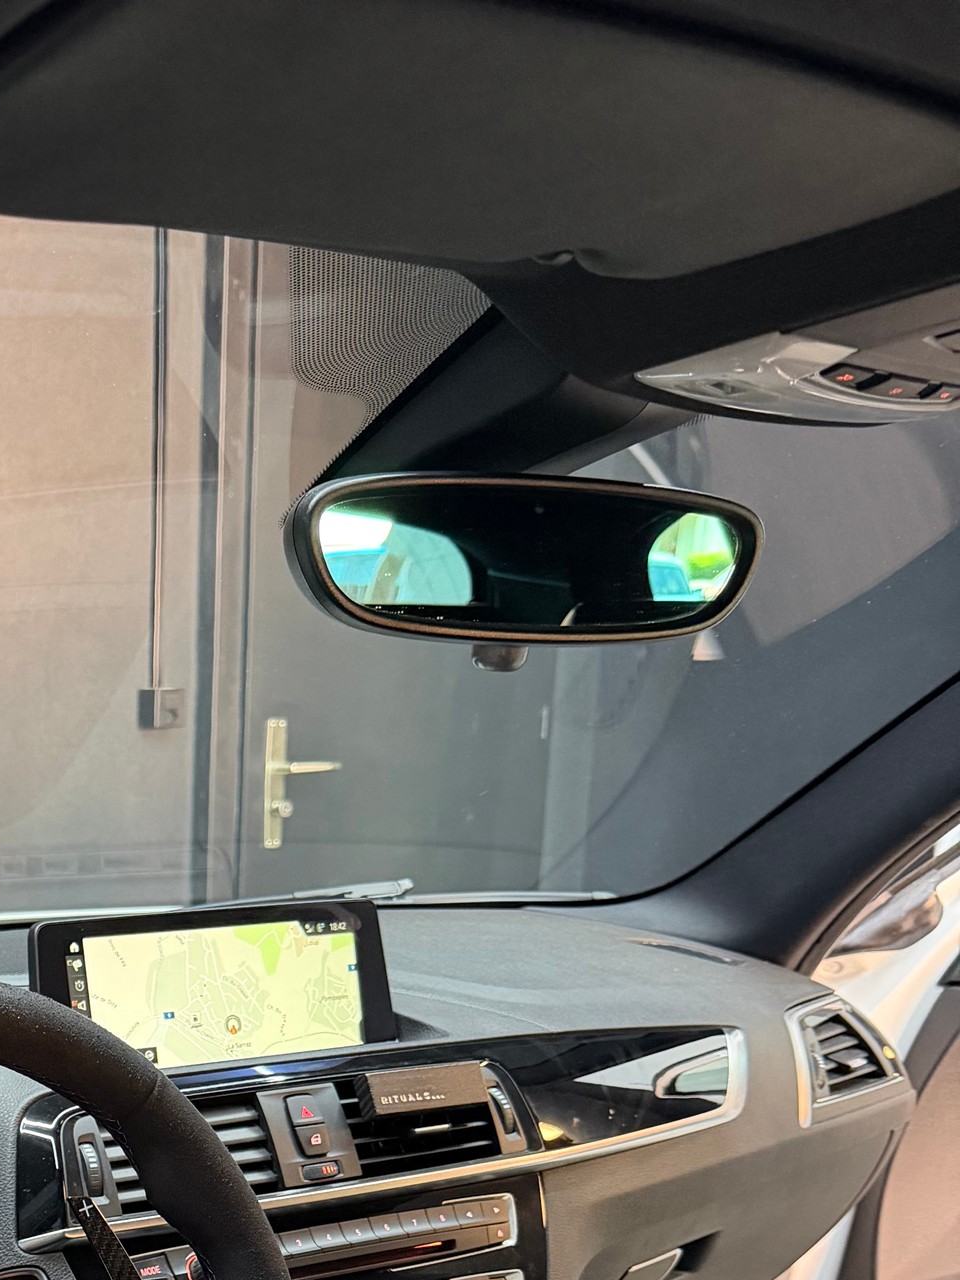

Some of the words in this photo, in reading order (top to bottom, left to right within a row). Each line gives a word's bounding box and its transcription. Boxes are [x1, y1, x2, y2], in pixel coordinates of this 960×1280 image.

[439, 1214, 446, 1222] 8
[411, 1218, 418, 1227] 7
[383, 1223, 390, 1231] 6
[355, 1228, 362, 1236] 5
[326, 1233, 332, 1241] 4
[295, 1239, 302, 1247] 3
[140, 1265, 162, 1277] MODE
